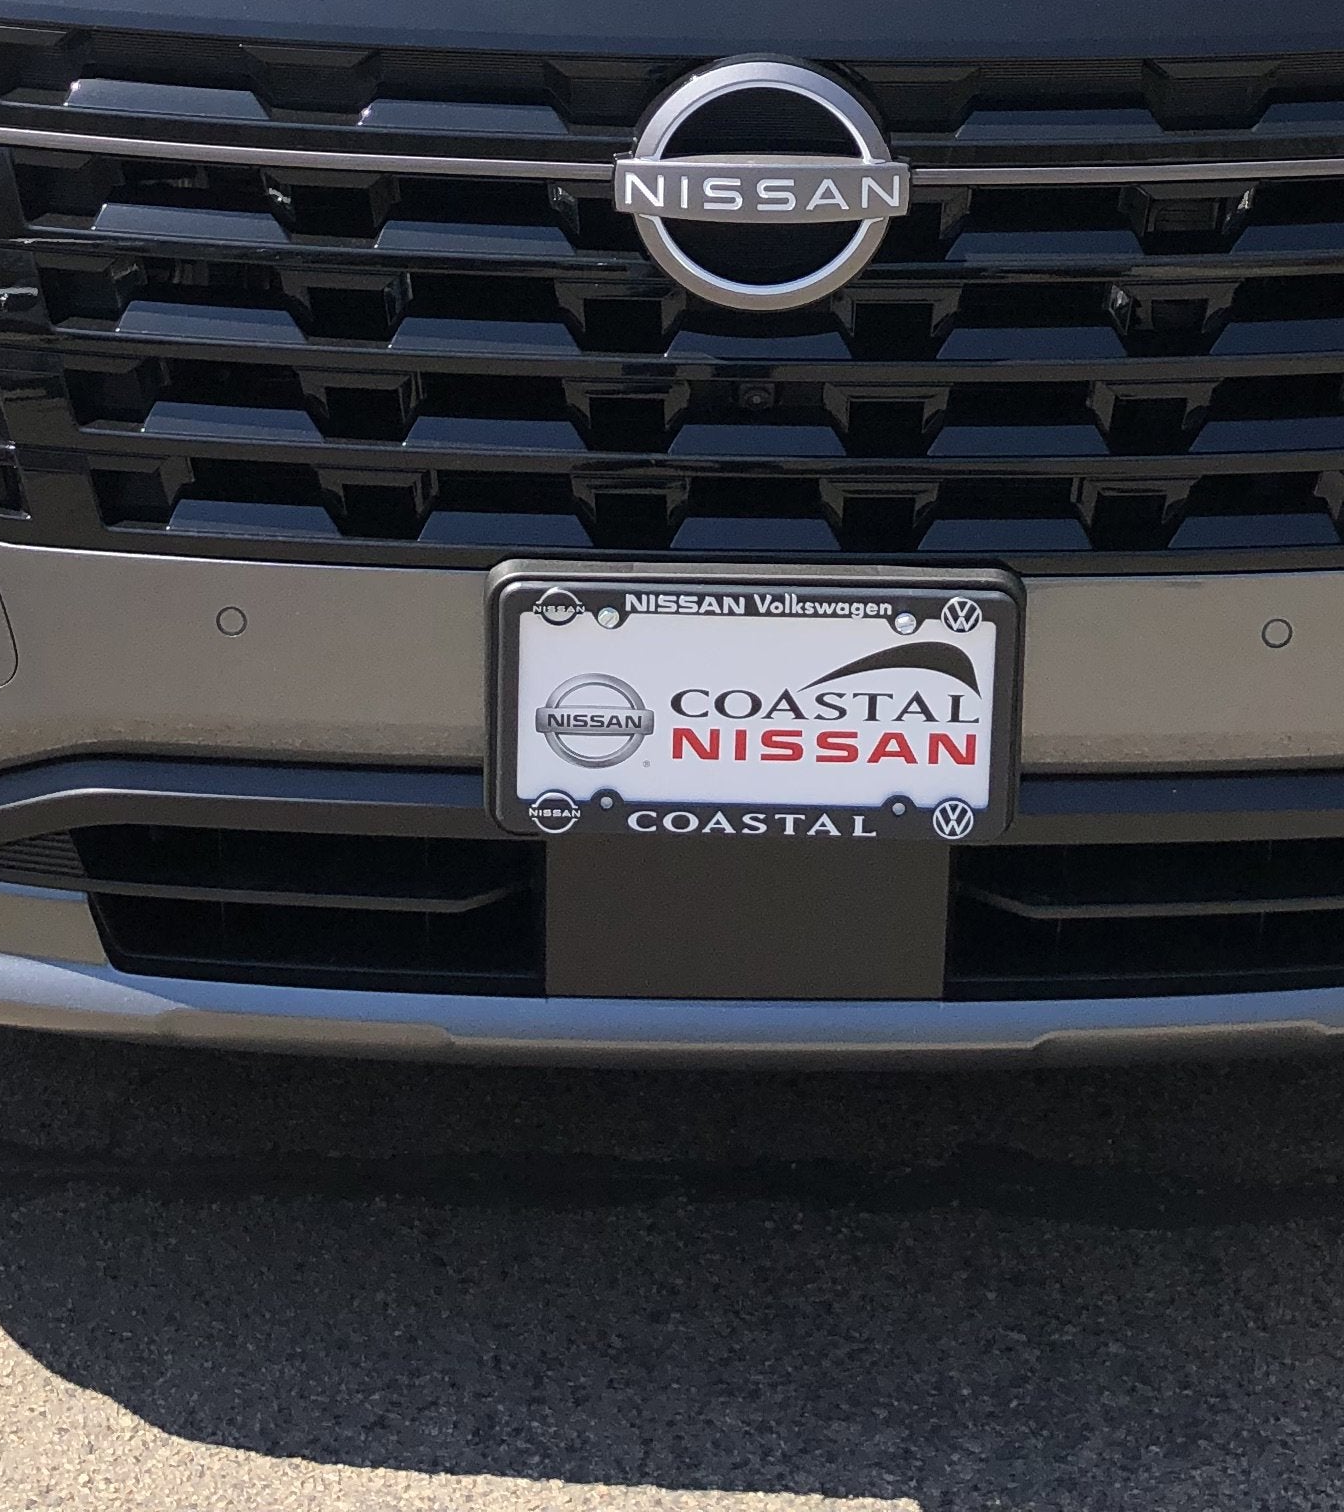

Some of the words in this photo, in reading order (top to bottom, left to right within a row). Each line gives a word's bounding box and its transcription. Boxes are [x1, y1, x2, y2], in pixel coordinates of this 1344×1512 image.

[624, 172, 900, 210] NISSAN
[532, 605, 585, 613] NISSAN
[625, 593, 745, 615] NISSAN
[754, 593, 892, 619] Volkswagen
[670, 688, 980, 723] COASTAL
[547, 713, 642, 729] NISSAN
[671, 728, 977, 765] NISSAN
[528, 807, 581, 818] NISSAN
[627, 811, 877, 838] COASTAL
